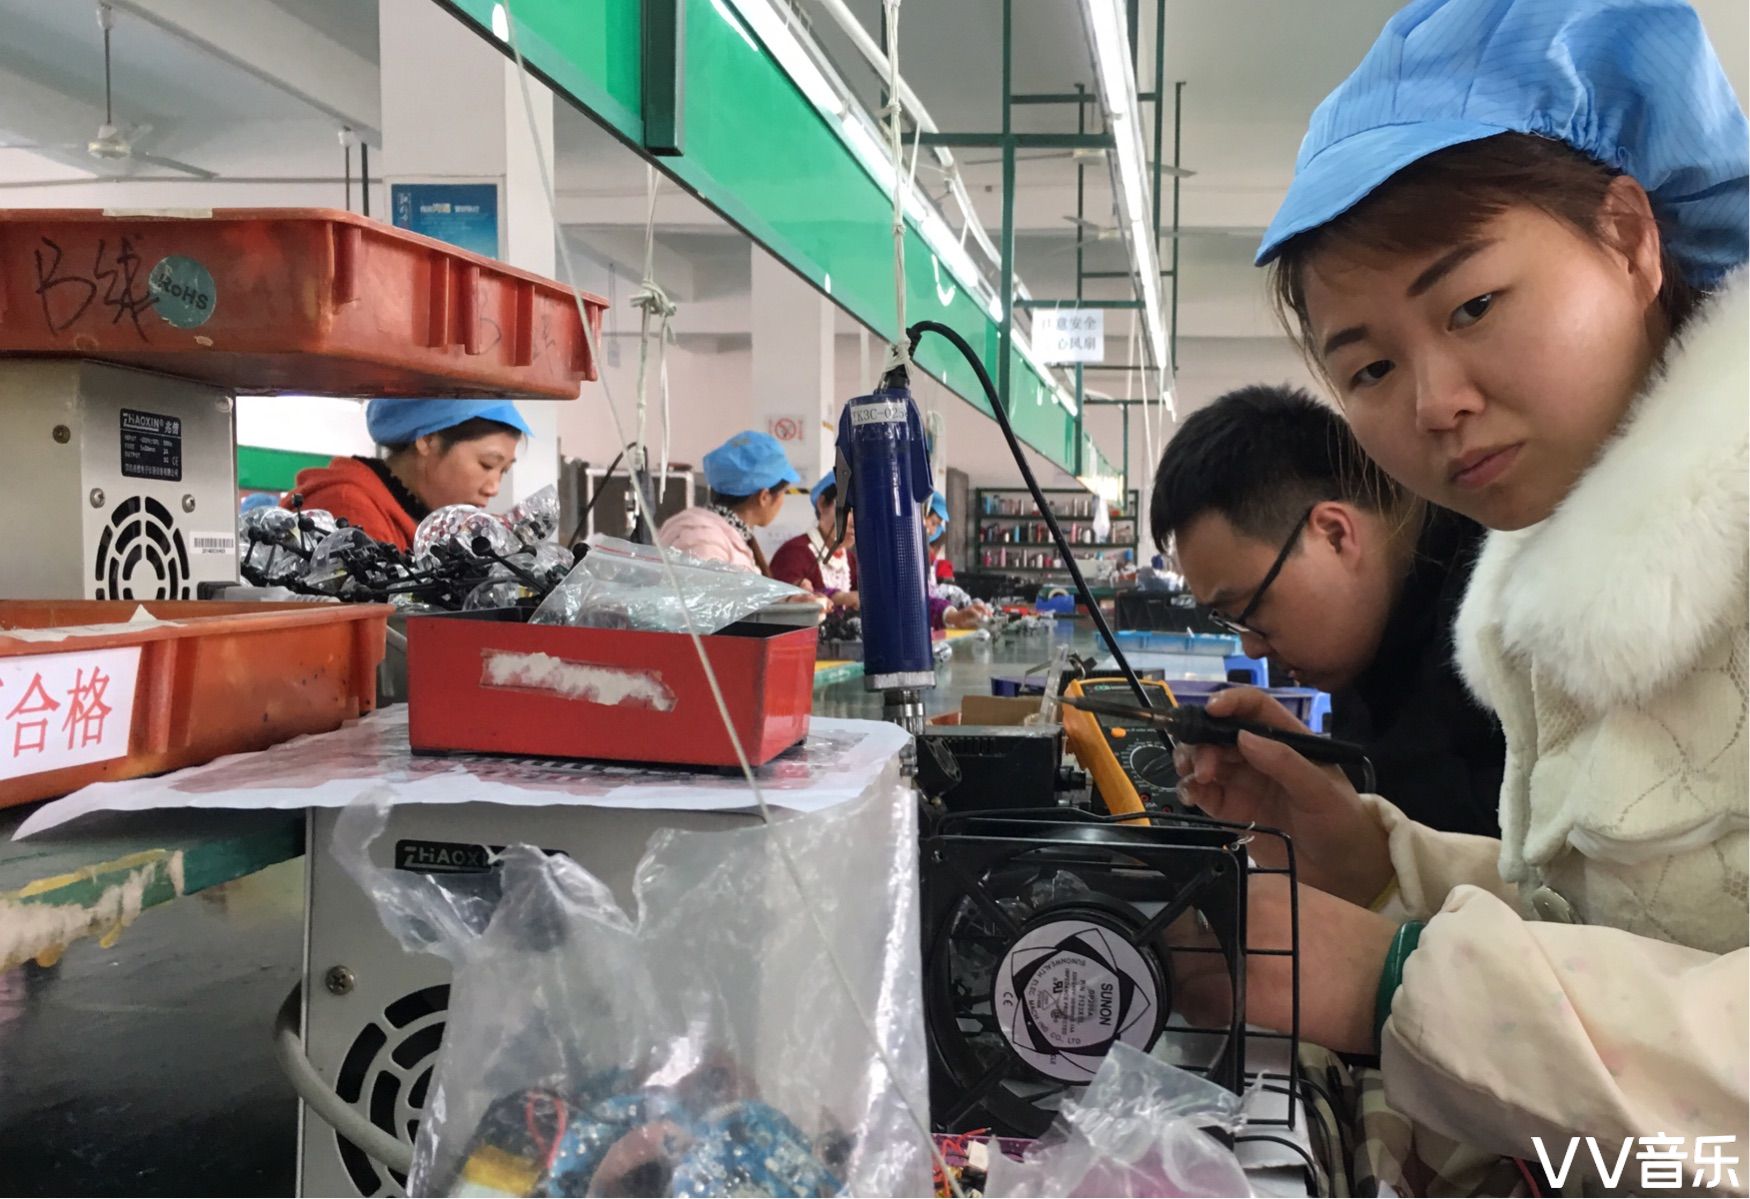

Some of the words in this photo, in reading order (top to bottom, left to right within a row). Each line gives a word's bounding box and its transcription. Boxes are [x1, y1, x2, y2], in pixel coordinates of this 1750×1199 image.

[159, 273, 209, 310] RoHS
[1041, 315, 1097, 331] 意安全
[0, 666, 112, 758] 合格
[1099, 982, 1113, 1026] SUNON
